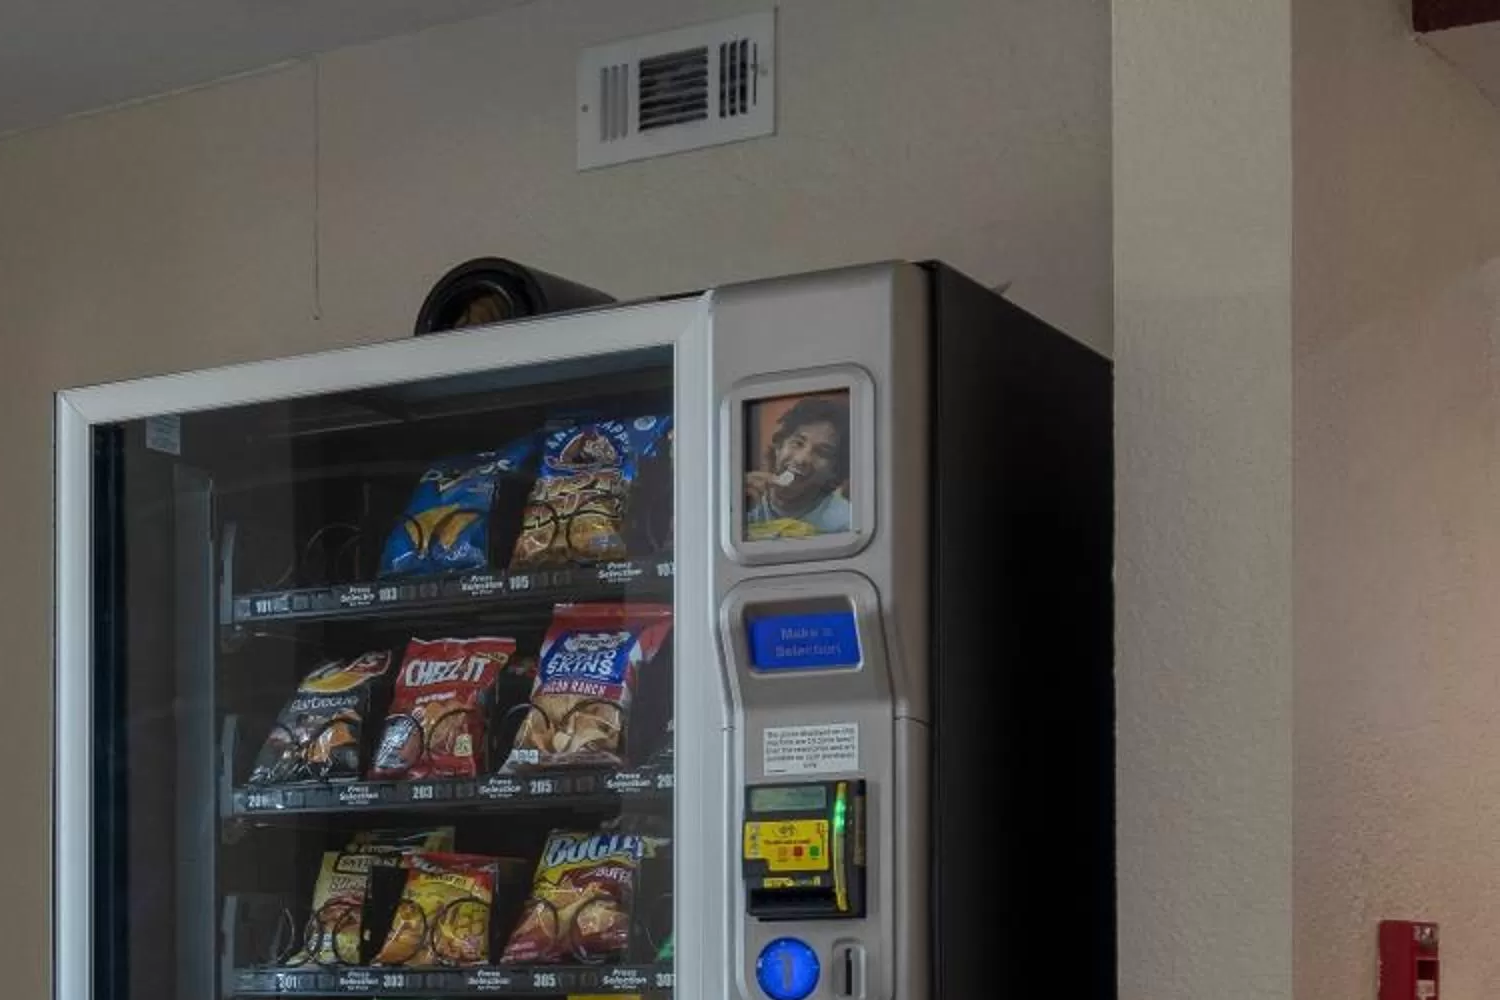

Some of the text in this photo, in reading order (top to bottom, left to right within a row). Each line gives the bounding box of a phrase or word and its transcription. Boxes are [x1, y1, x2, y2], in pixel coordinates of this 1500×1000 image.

[545, 657, 614, 676] SKINS
[411, 785, 434, 800] 203
[528, 779, 553, 795] 205
